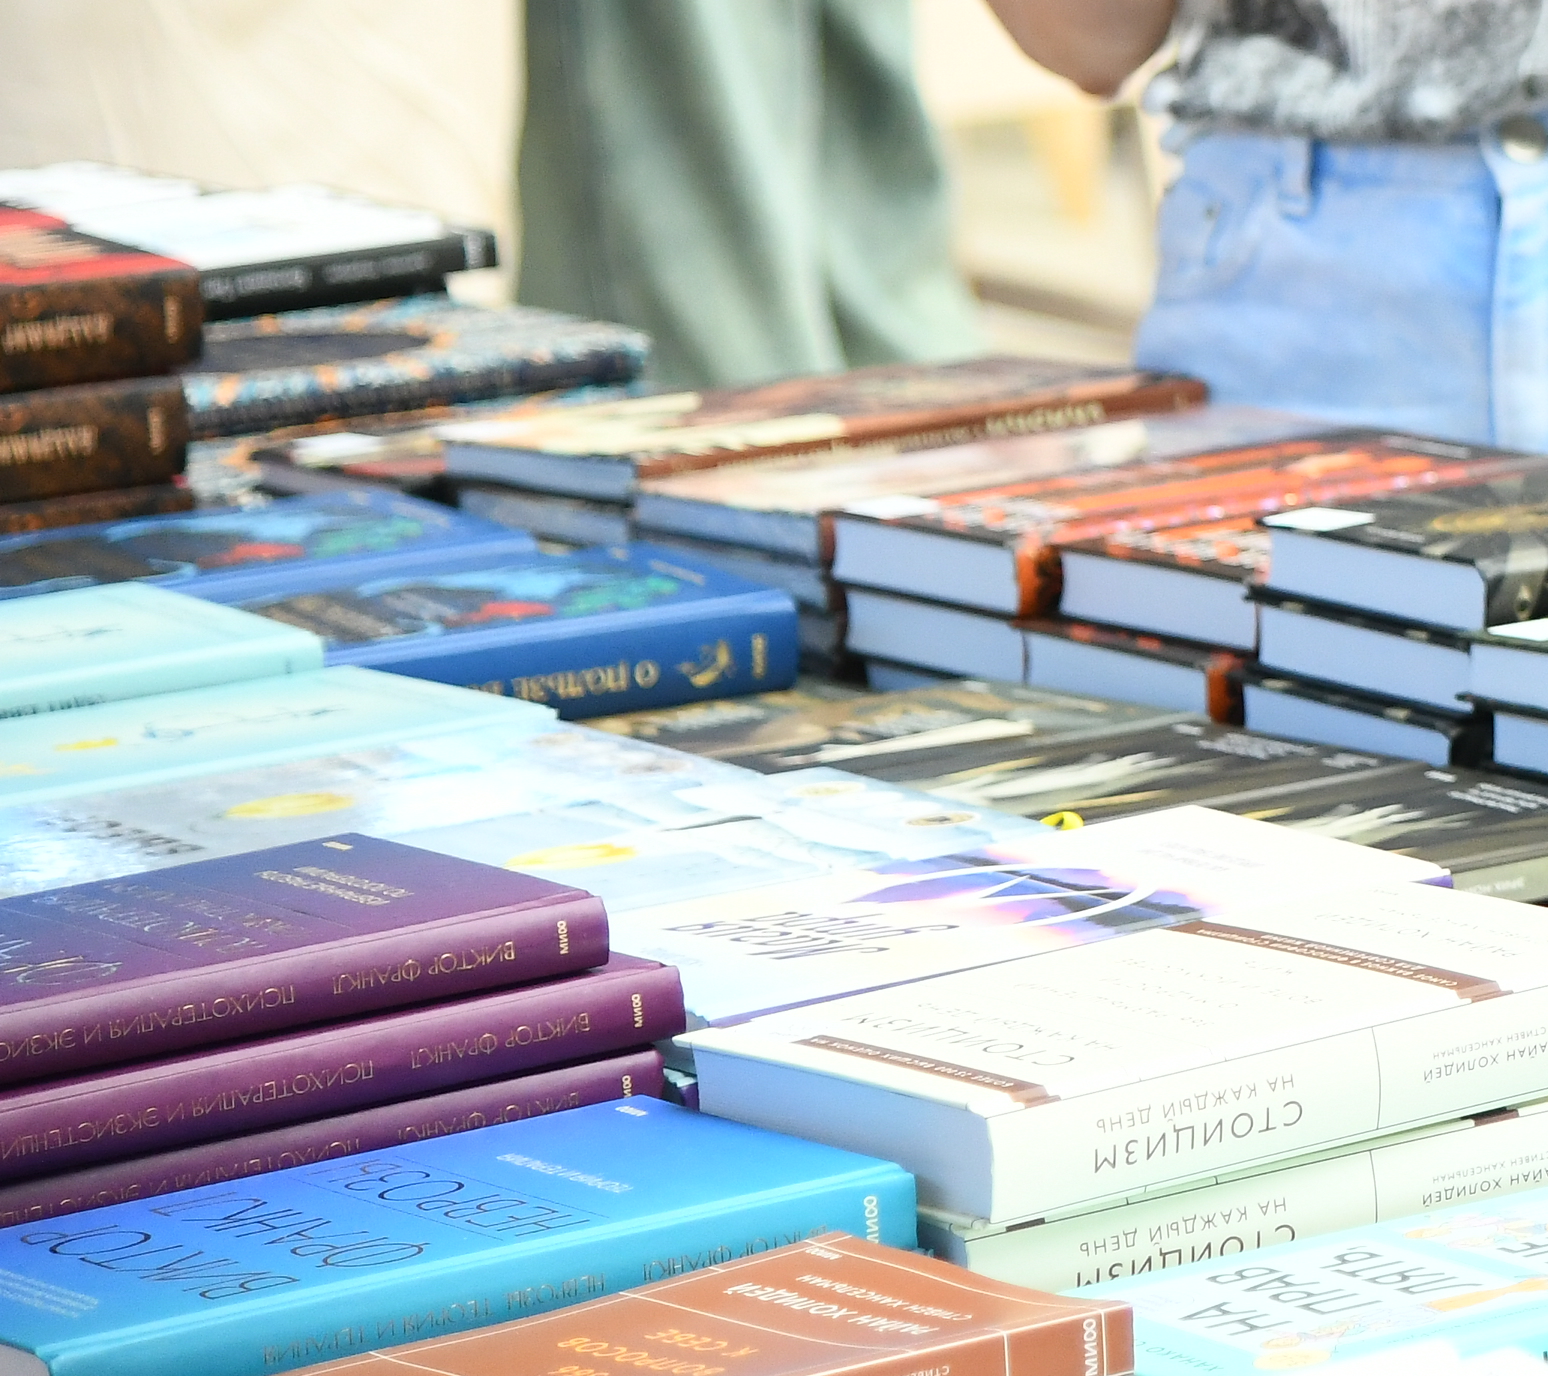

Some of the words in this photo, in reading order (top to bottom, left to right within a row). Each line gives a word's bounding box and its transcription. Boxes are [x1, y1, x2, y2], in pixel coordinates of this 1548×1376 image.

[331, 958, 421, 995] ФРАНКЛ
[425, 941, 517, 976] ВИКТОР
[107, 983, 295, 1040] ПСИХОТЕРАПИЯ
[504, 1011, 590, 1048] ВИКТОР
[81, 1024, 101, 1045] И
[410, 1031, 498, 1070] ФРАНКЛ
[1432, 1036, 1503, 1061] ХАНСЕЛЬМАН
[1505, 1025, 1548, 1044] СТИВЕН
[1265, 1073, 1295, 1090] НА
[1422, 1052, 1500, 1085] ХОЛИДЕЙ
[191, 1059, 375, 1117] ПСИХОТЕРАПИЯ
[1161, 1082, 1257, 1124] КАЖДЫЙ
[167, 1102, 186, 1122] И
[1095, 1106, 1152, 1134] ДЕНЬ
[1093, 1100, 1304, 1174] СТОИЦИЗМ
[1431, 1160, 1506, 1185] ХАНСЕЛЬМАН
[303, 1159, 589, 1238] НЕВРОЗЫ
[1257, 1197, 1287, 1213] НА
[1420, 1176, 1503, 1209] ХОЛИДЕЙ
[148, 1192, 425, 1270] ФРАНКЛ
[1079, 1227, 1138, 1258] ДЕНЬ
[1148, 1205, 1248, 1247] КАЖДЫЙ
[20, 1224, 298, 1301] ВИКТОР
[722, 1281, 856, 1329] ХОЛИДЕЙ
[795, 1274, 915, 1313] ХАНСЕЛЬМАН
[906, 1295, 976, 1324] СТИВЕН
[1203, 1267, 1383, 1316] ПРАВ
[1177, 1301, 1294, 1337] НА
[643, 1328, 729, 1352] СЕБЕ
